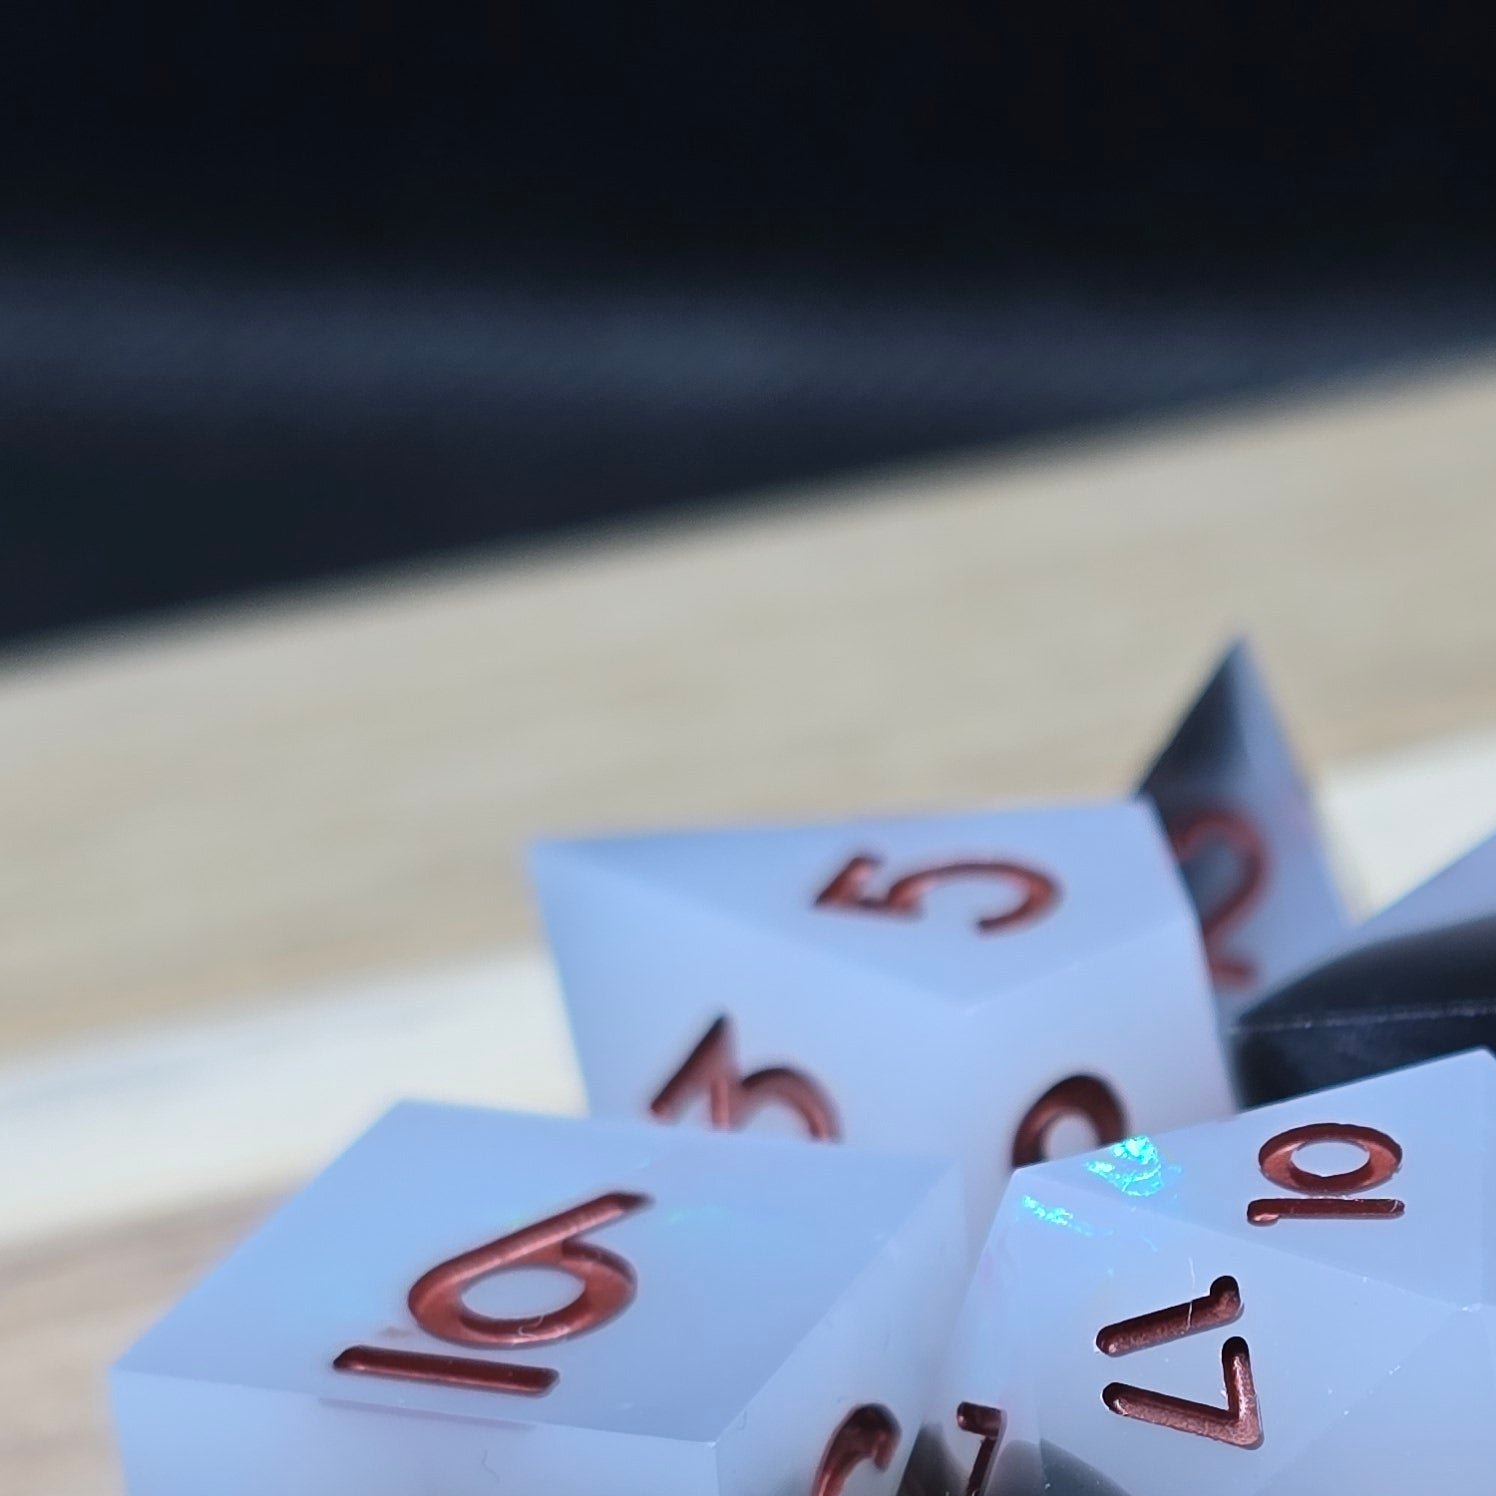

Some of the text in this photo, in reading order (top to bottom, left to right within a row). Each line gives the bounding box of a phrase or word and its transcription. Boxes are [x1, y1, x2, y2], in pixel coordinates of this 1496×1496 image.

[812, 850, 1064, 938] 5
[1246, 1121, 1406, 1227] 10
[1096, 1275, 1263, 1450] 17
